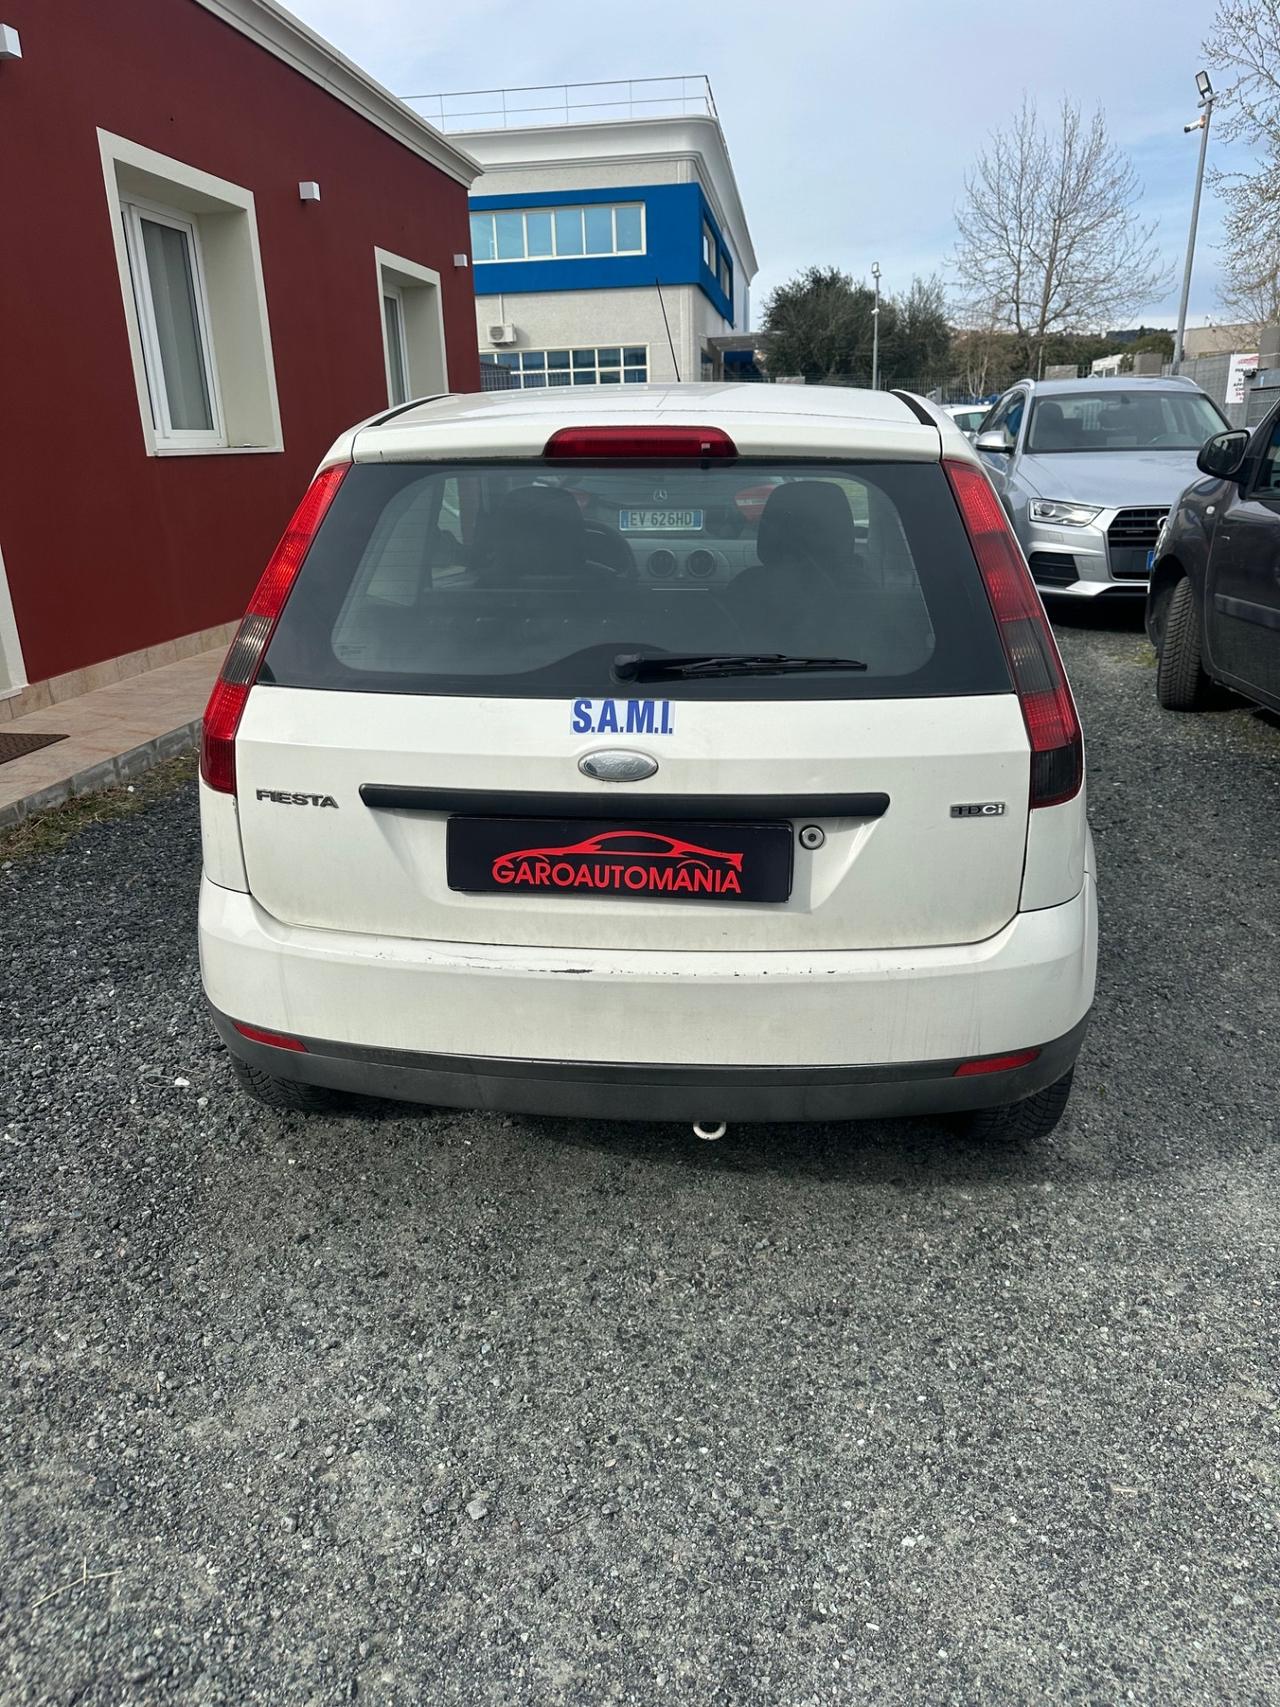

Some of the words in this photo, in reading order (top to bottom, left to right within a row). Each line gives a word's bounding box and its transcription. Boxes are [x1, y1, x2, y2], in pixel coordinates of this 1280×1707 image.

[630, 512, 647, 526] EV
[651, 512, 692, 527] 626HD
[573, 699, 673, 734] S.A.M.I.
[256, 789, 339, 809] FIESTA
[951, 804, 1003, 816] TDCi
[492, 861, 742, 893] GAROAUTOMANIA
